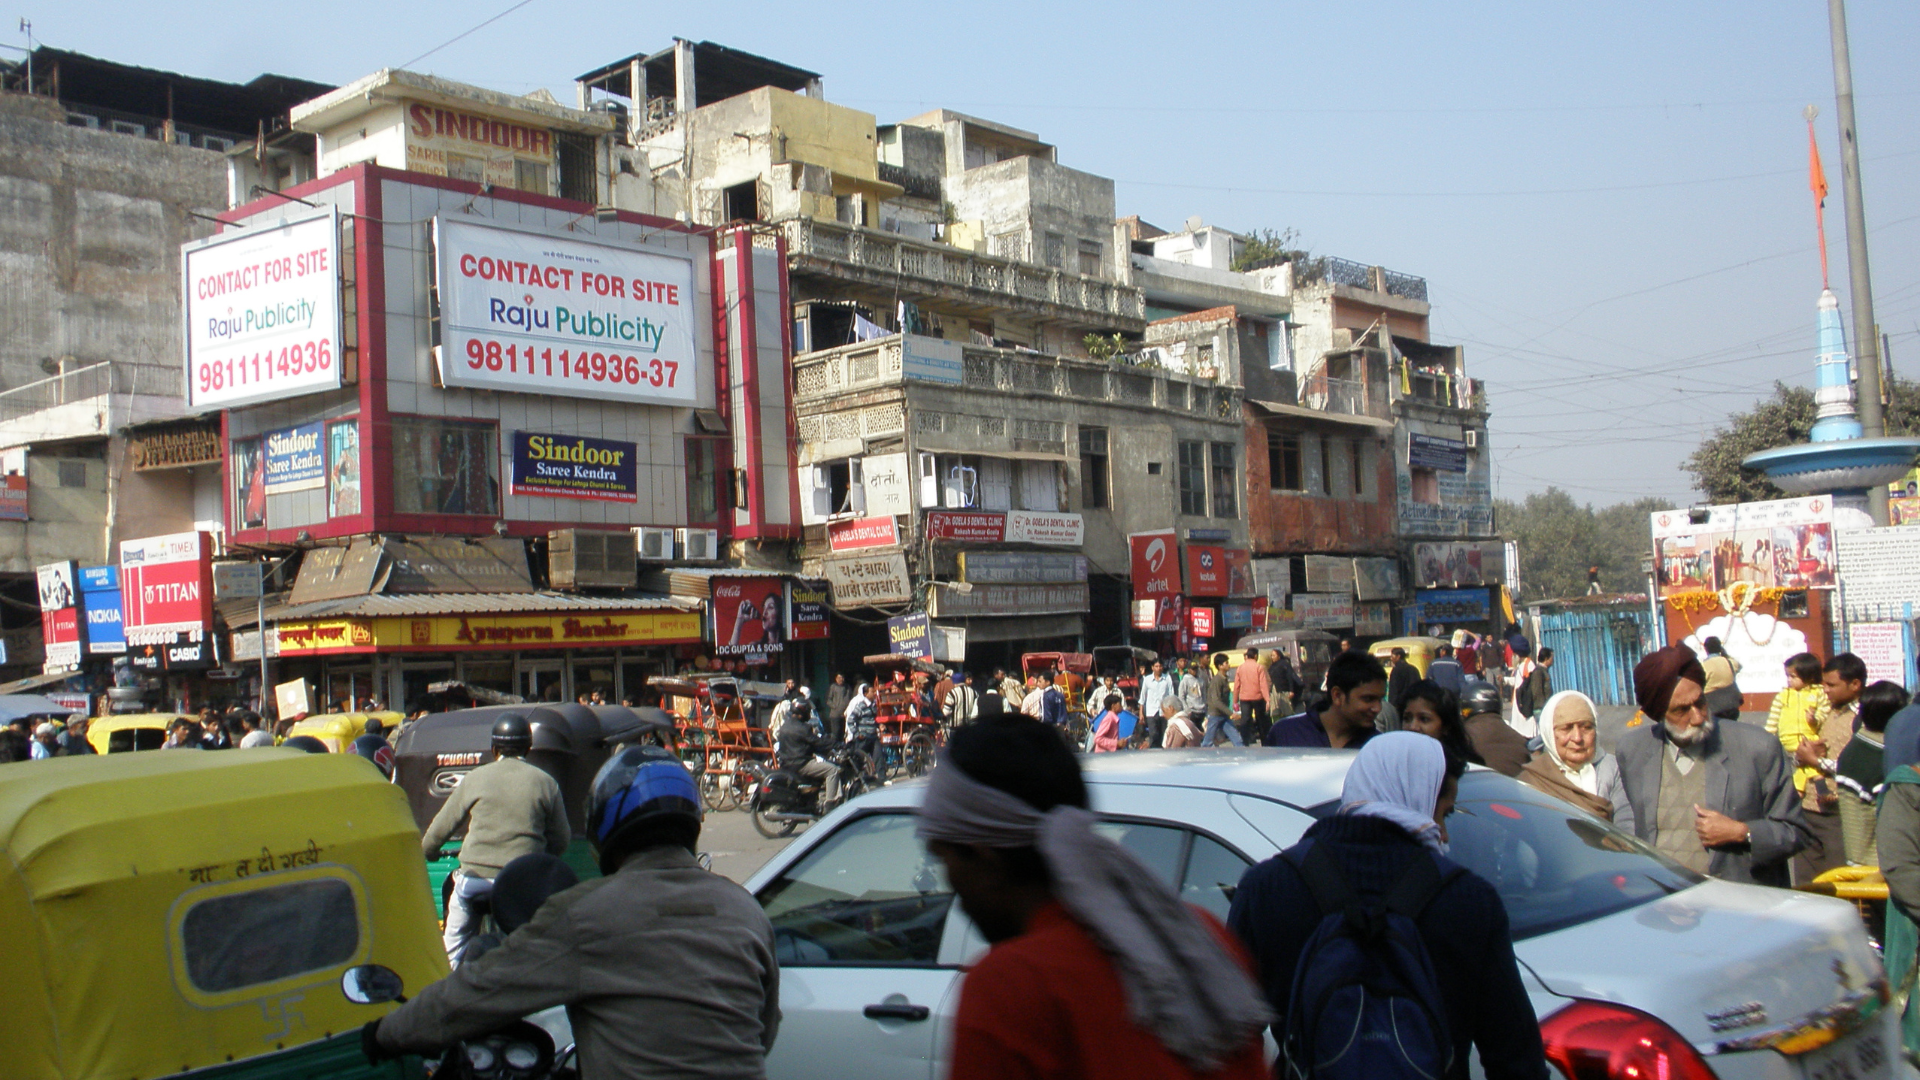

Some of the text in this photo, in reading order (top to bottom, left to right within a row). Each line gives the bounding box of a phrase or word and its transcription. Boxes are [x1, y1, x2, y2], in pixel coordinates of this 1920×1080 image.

[409, 103, 550, 155] SINDOOR
[407, 144, 445, 164] SAREE
[198, 247, 328, 301] CONTACT FOR SITE
[460, 254, 573, 291] CONTACT
[581, 271, 625, 298] FOR
[632, 279, 679, 305] SITE
[209, 297, 316, 340] Raju Publicity
[490, 297, 664, 353] Raju Publicity
[199, 338, 331, 394] 9811114936
[466, 339, 679, 388] 9811114936-37
[268, 430, 318, 457] Sindoor
[528, 436, 624, 466] Sindoor
[266, 452, 322, 474] Saree Kendra
[536, 462, 617, 481] Saree Kendra
[971, 517, 987, 527] DENTAL
[1050, 518, 1065, 528] DENTAL
[170, 541, 195, 554] TIMEX
[1146, 578, 1169, 592] airtel
[1199, 572, 1217, 582] kotak
[155, 581, 199, 603] TITAN
[792, 587, 827, 604] Sindoor
[87, 608, 122, 624] NOKIA
[800, 603, 820, 612] Saree
[1193, 618, 1210, 628] ATM
[890, 623, 926, 644] Sindoor
[169, 647, 200, 662] CASIO
[719, 645, 730, 655] DC
[731, 643, 756, 653] GUPTA
[763, 642, 783, 652] SONS
[900, 640, 919, 651] Saree
[436, 752, 482, 766] TOURIST
